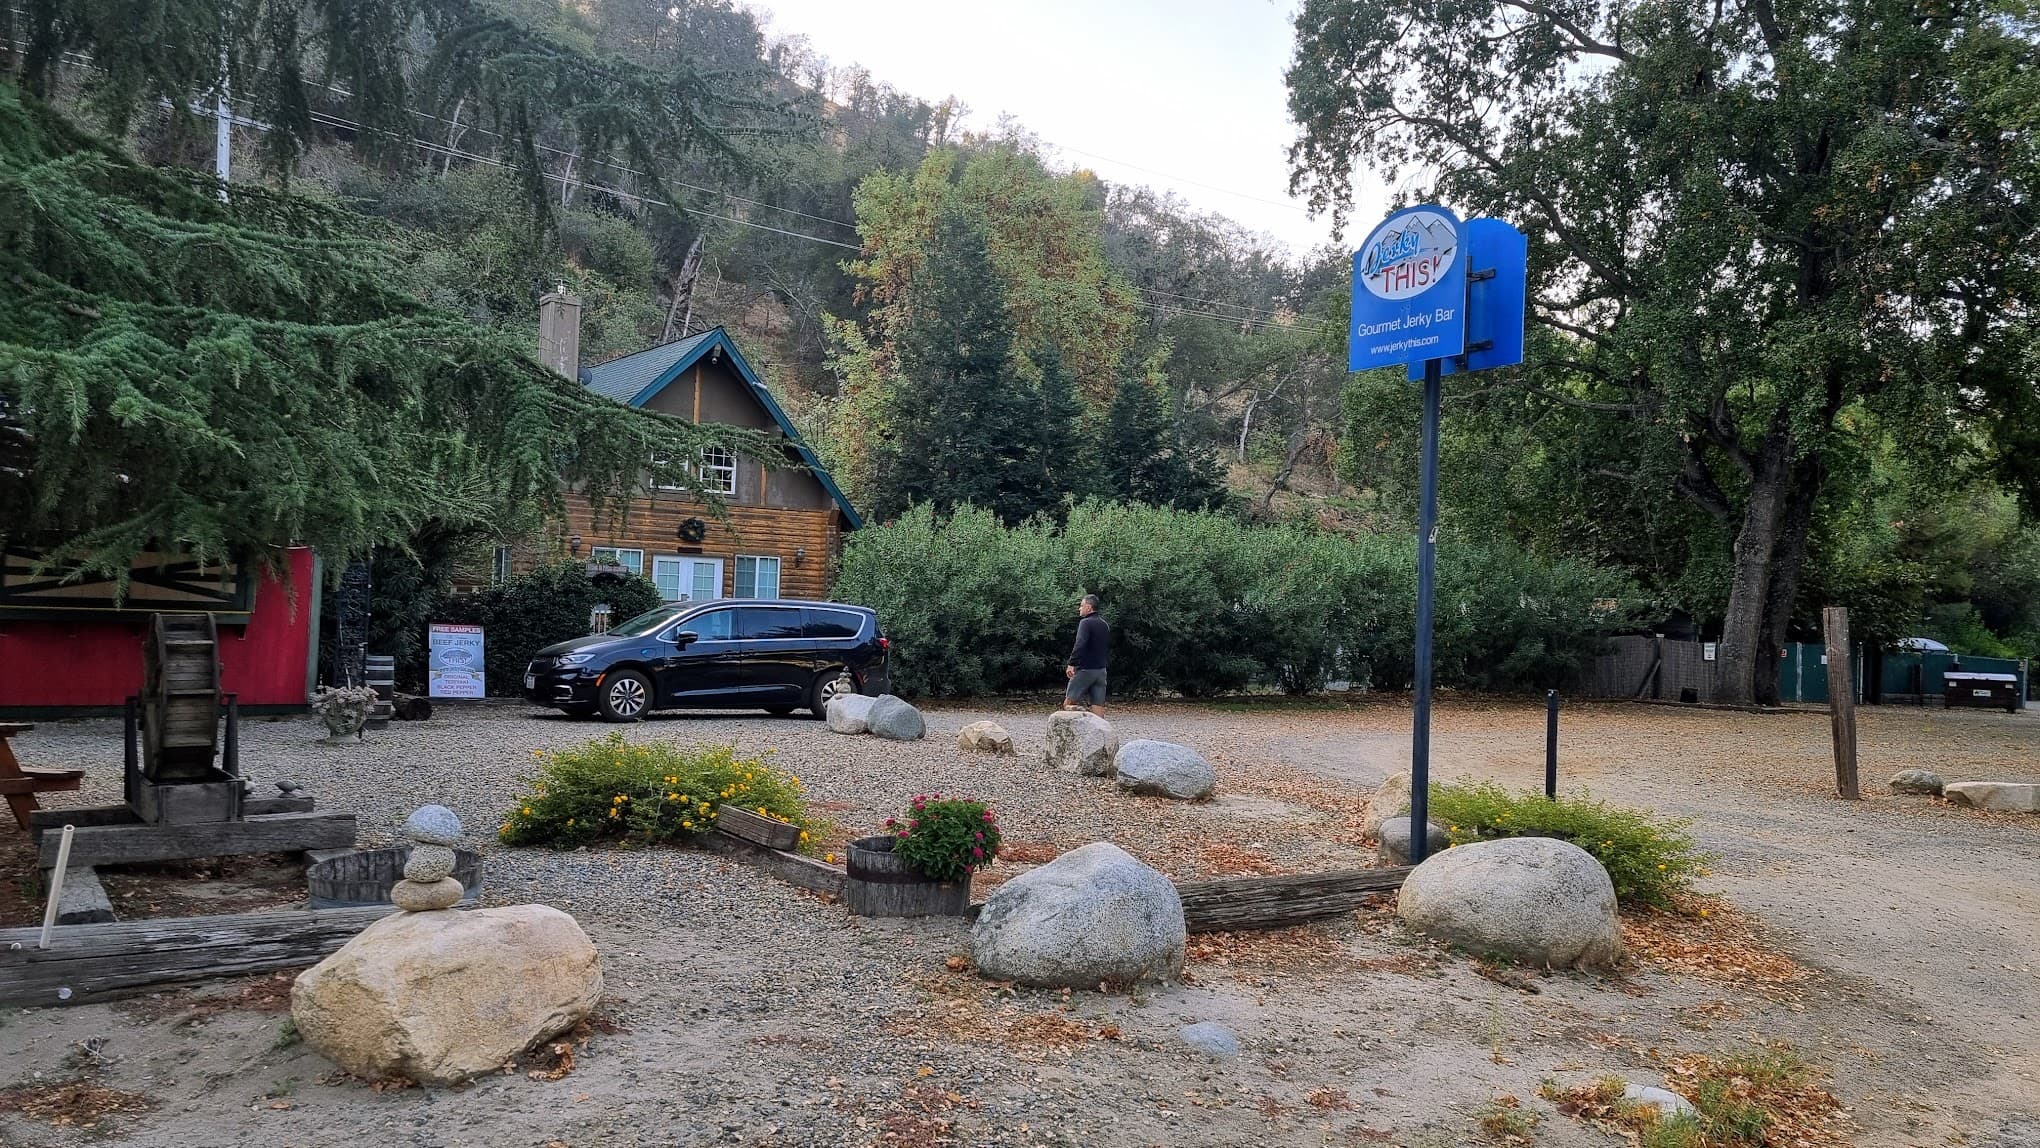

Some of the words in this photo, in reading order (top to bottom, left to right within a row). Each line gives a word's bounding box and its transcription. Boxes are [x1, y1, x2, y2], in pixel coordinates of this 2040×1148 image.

[1368, 229, 1420, 274] Jerky
[1381, 255, 1439, 293] THIS!
[1358, 317, 1401, 337] Gourmet
[1403, 312, 1432, 328] Jerky
[1435, 308, 1455, 322] Bar
[1370, 335, 1439, 355] www.jerkythis.com
[454, 639, 481, 647] JERKY
